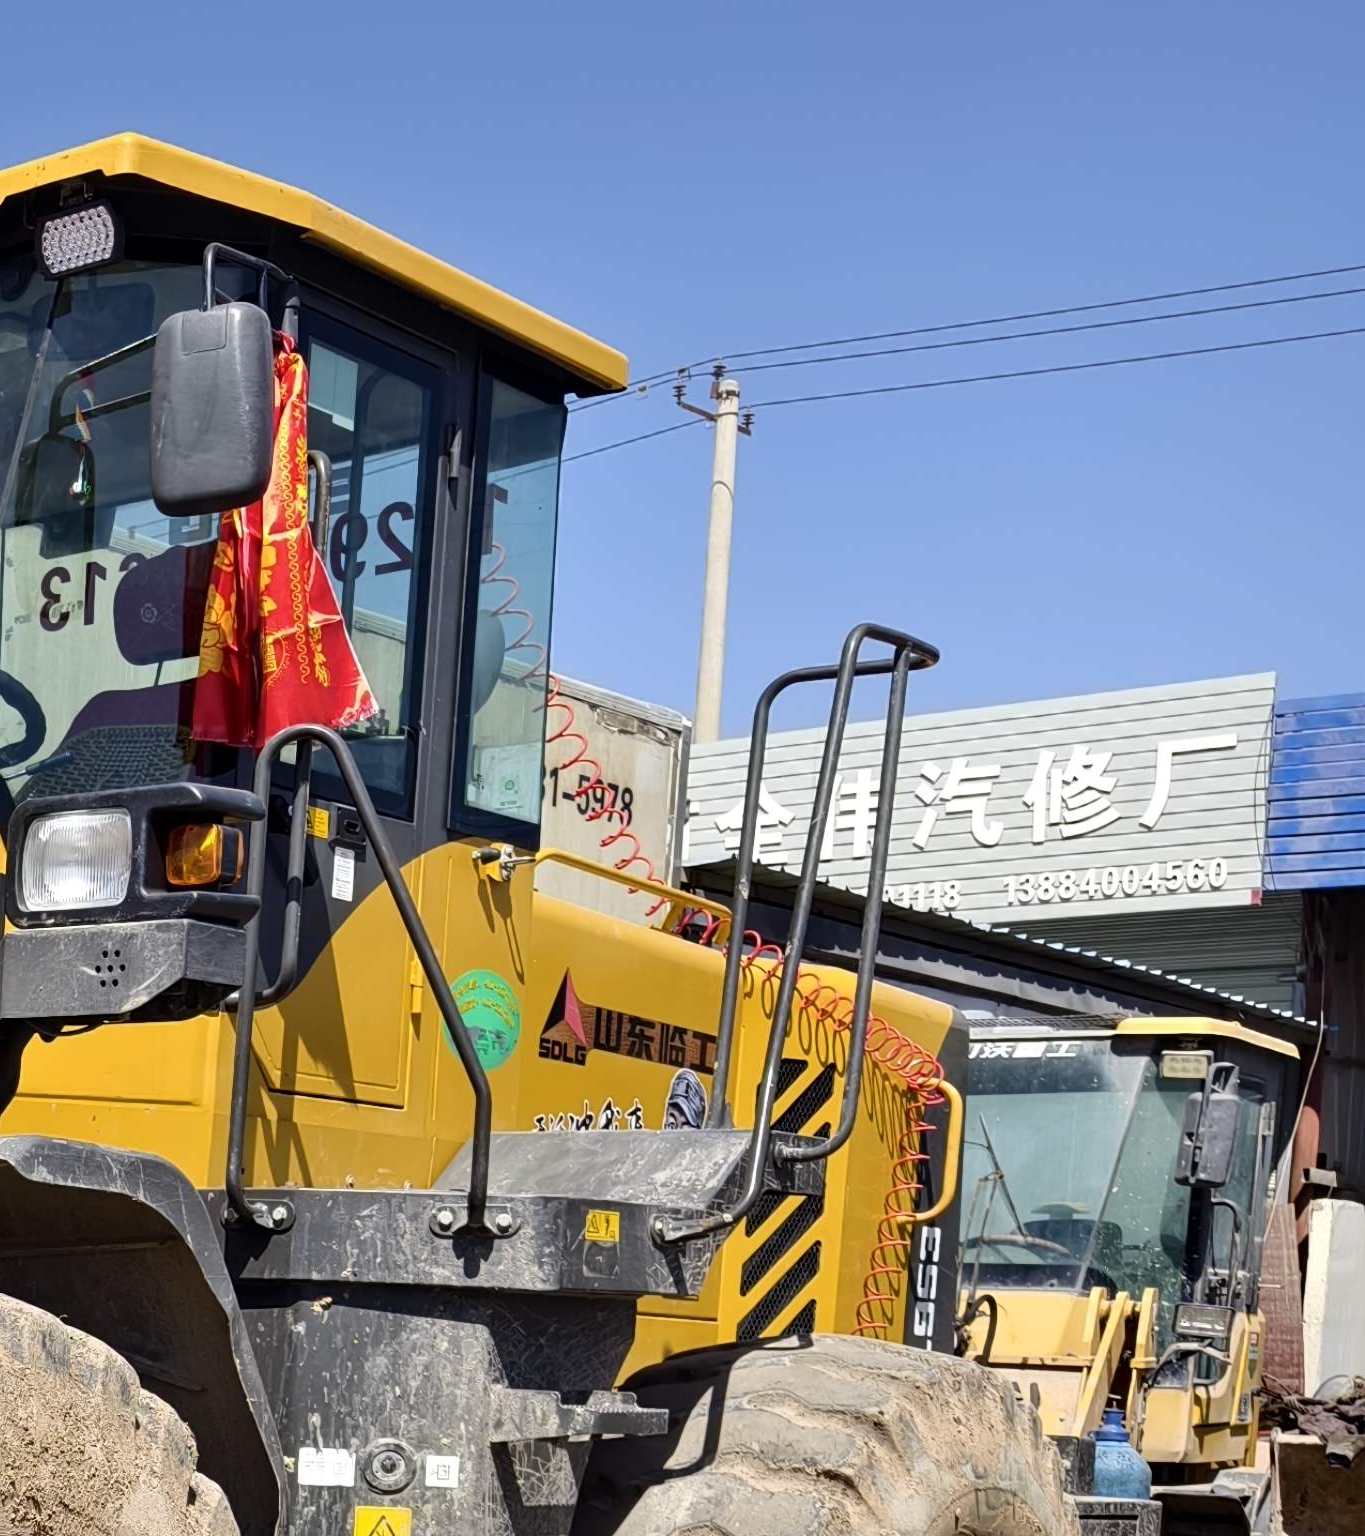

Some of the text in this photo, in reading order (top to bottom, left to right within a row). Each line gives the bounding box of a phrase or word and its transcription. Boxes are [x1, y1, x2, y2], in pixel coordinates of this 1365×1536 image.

[1002, 857, 1229, 904] 13884004560
[538, 1006, 719, 1076] SDLG 山东临工
[913, 1225, 942, 1352] 953
